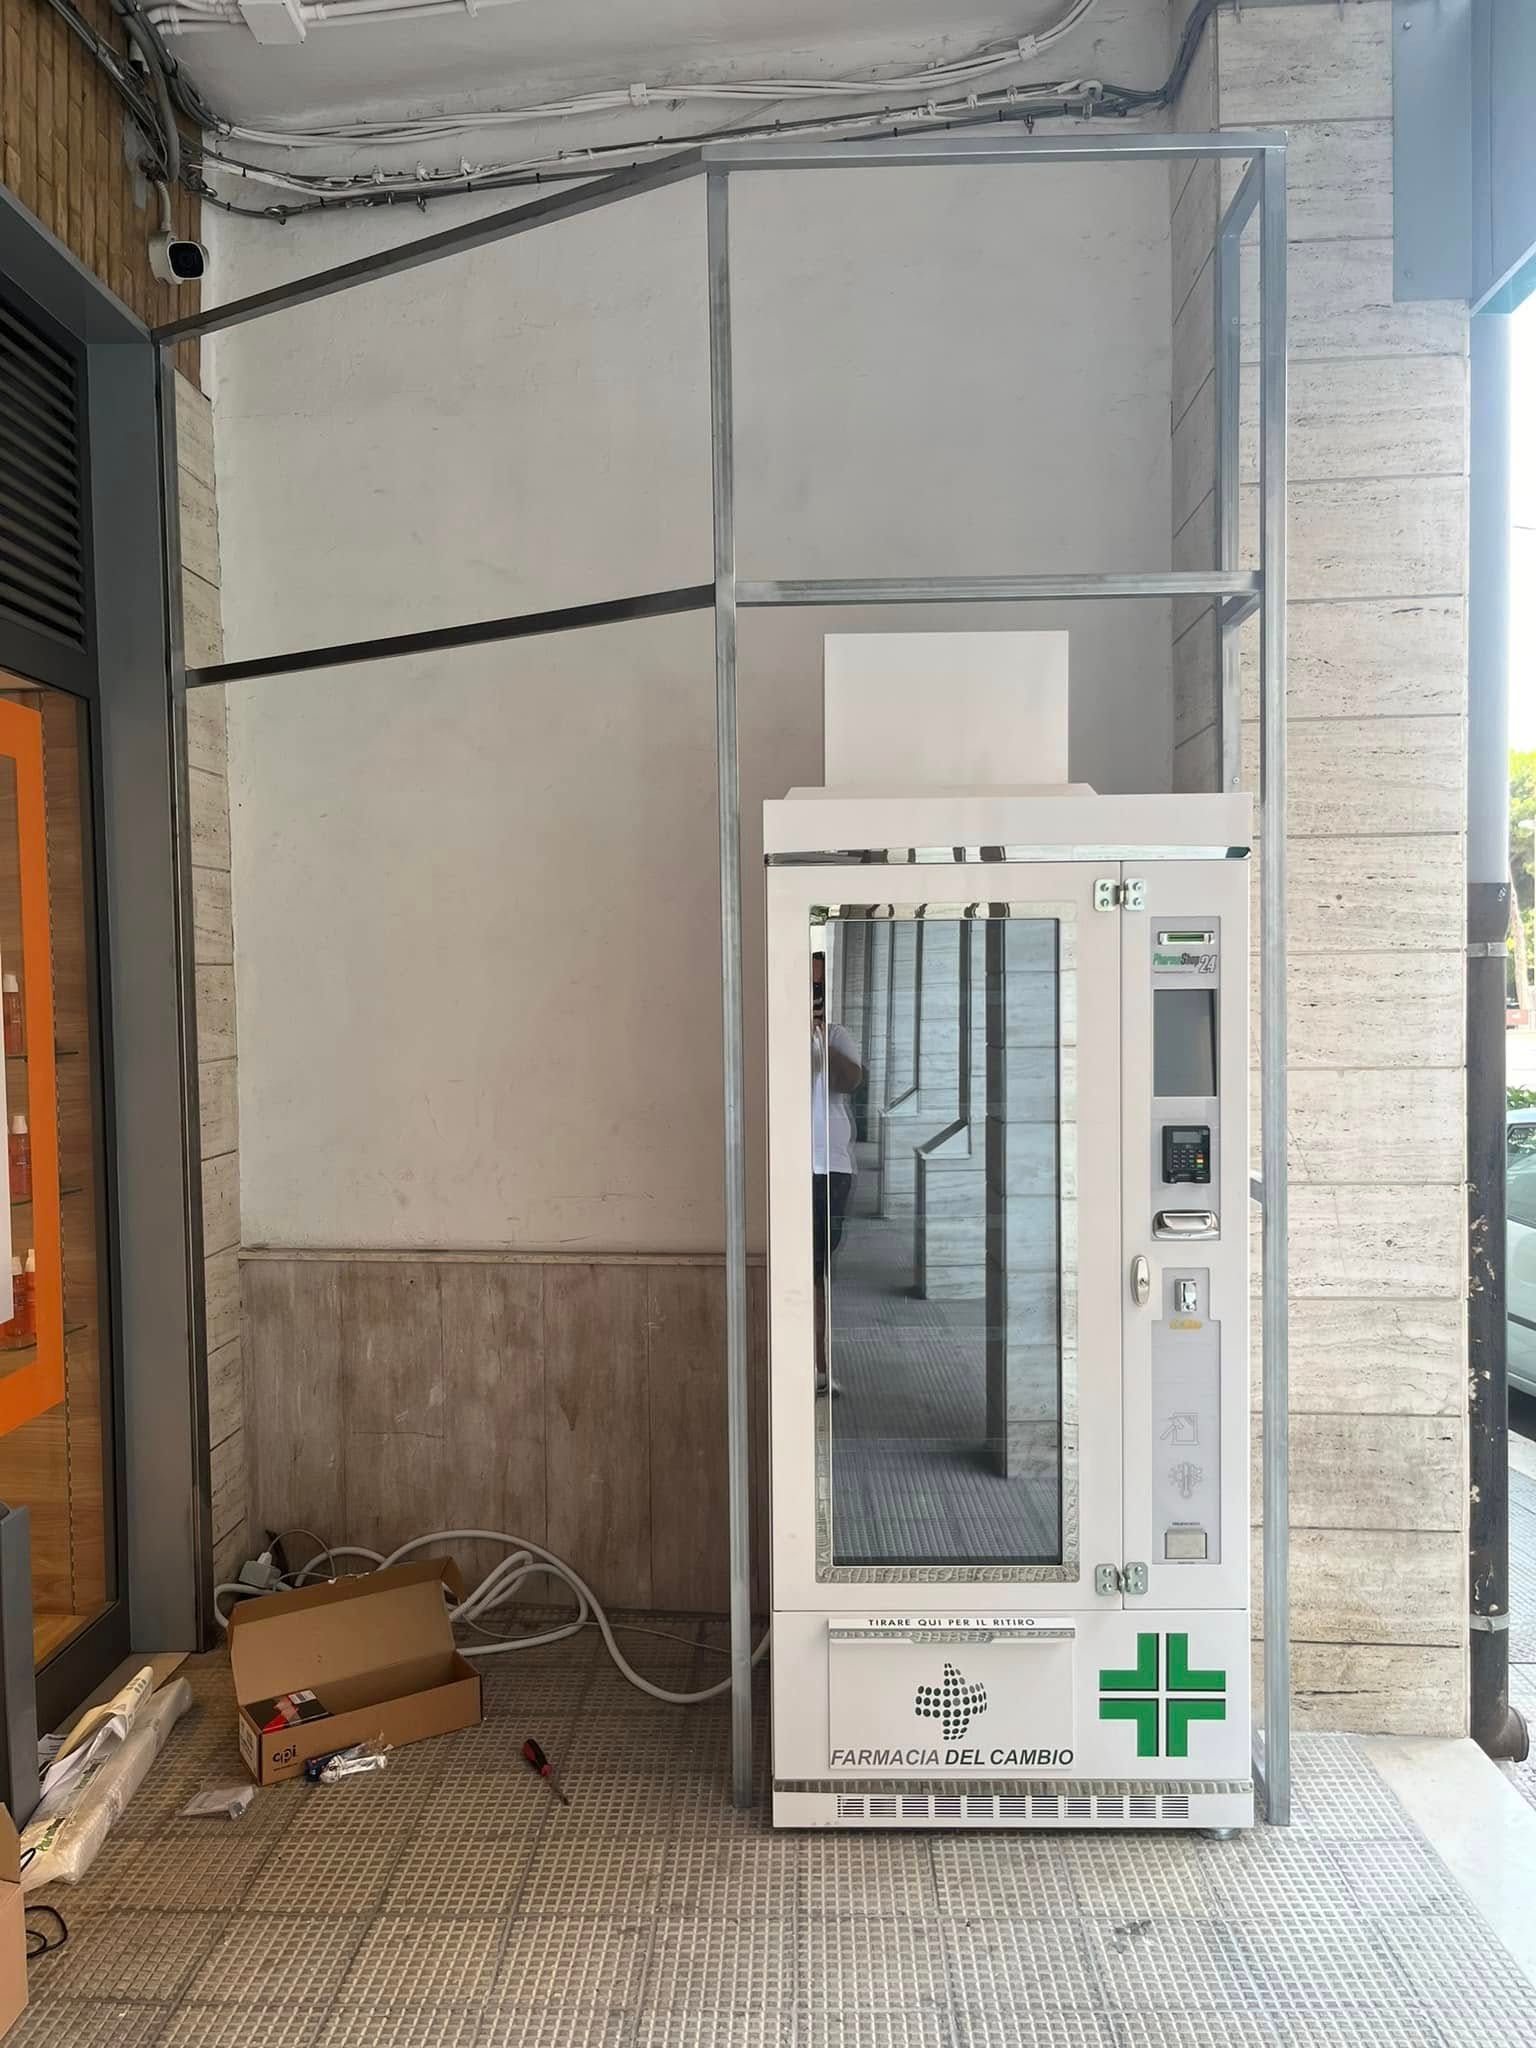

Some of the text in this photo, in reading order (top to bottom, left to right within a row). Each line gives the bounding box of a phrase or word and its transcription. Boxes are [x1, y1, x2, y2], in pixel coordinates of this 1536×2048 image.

[868, 1618, 1036, 1627] TIRARE QUI PER IL RITIRO
[831, 1749, 1074, 1766] FARMACIA DEL CAMBIO
